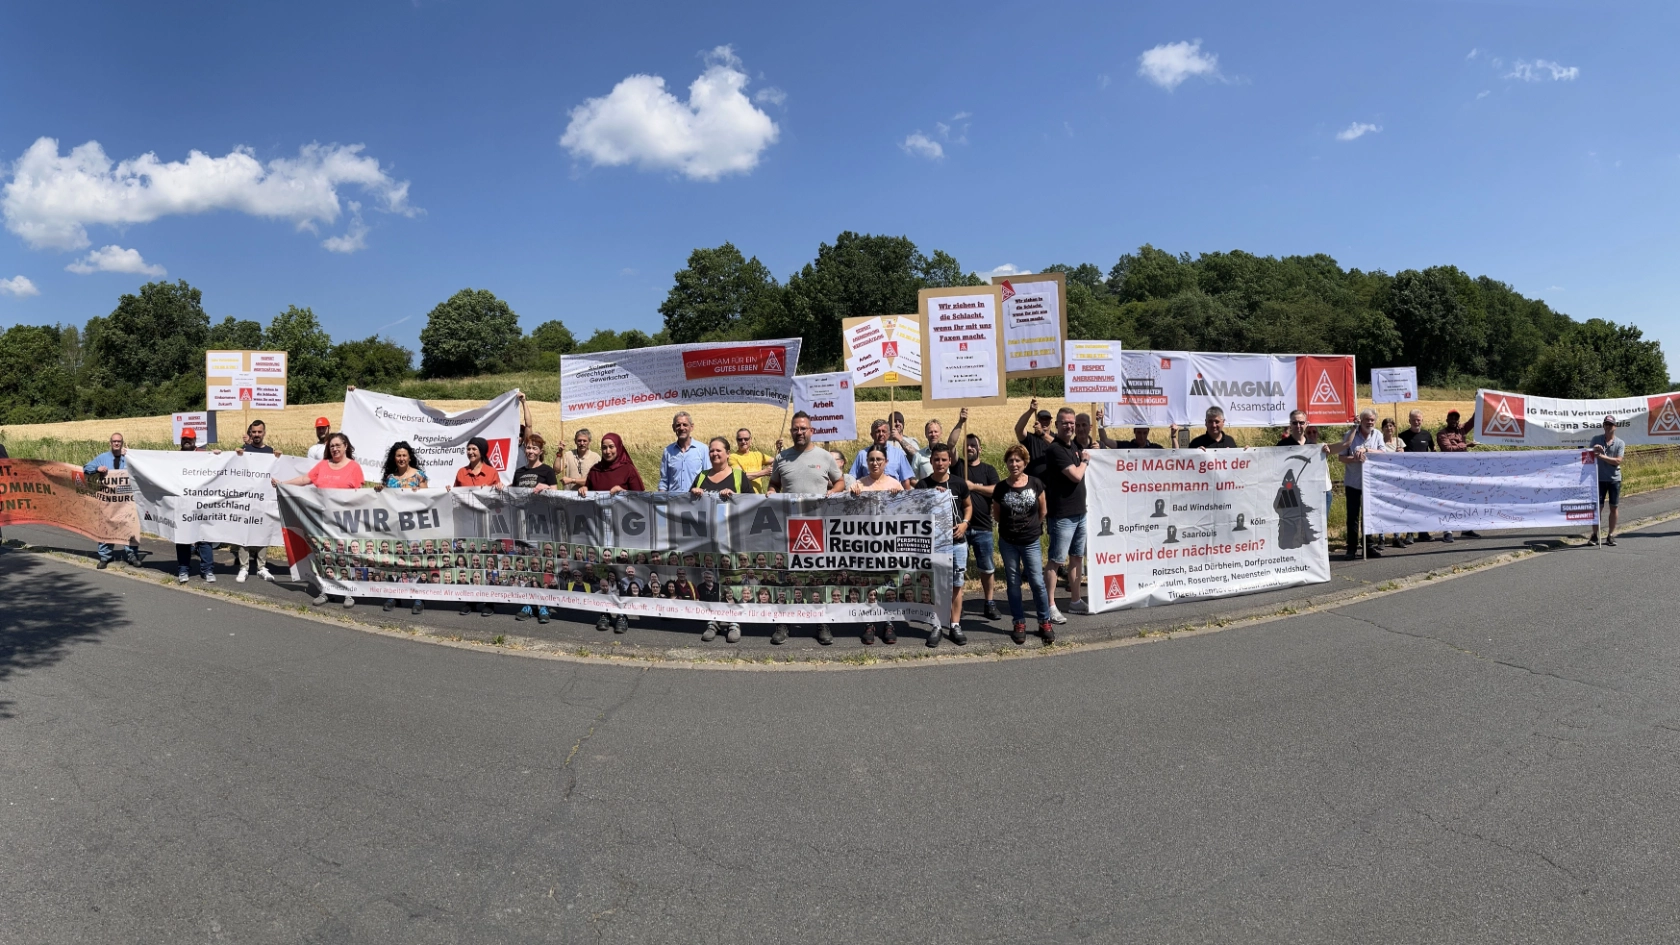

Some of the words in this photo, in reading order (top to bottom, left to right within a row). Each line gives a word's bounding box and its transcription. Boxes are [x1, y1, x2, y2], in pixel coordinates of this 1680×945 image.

[938, 302, 952, 310] Wir
[952, 312, 984, 320] Schlacht,
[939, 334, 961, 342] Faxen
[738, 364, 758, 372] LEBEN
[681, 386, 719, 398] MAGNA
[1069, 384, 1118, 393] WERTSCHÄTZUNG
[1212, 380, 1285, 397] MAGNA
[568, 390, 678, 412] www.gutes-leben.de
[812, 400, 834, 408] Arbeit
[1230, 401, 1286, 412] Assamstadt
[383, 410, 424, 422] Betriebsrat
[1526, 407, 1537, 415] IG
[1540, 408, 1569, 416] Metall
[1571, 406, 1647, 417] Vertrauensleute
[810, 414, 844, 422] nkommen
[1582, 420, 1631, 429] Saauis
[412, 446, 466, 455] ndortsicherung
[418, 458, 454, 466] utschland
[1116, 460, 1137, 471] Bei
[1141, 460, 1194, 471] MAGNA
[1198, 458, 1228, 474] geht
[1230, 459, 1251, 470] der
[182, 468, 227, 476] Betriebsrat
[230, 469, 270, 478] Heilbronn
[1121, 480, 1208, 493] Sensenmann
[1215, 480, 1244, 490] um...
[183, 488, 264, 500] Standortsicherung
[196, 501, 250, 511] Deutschland
[1172, 504, 1187, 512] Bad
[1189, 502, 1231, 512] Windsheim
[182, 513, 227, 522] Solidarität
[229, 514, 242, 522] für
[244, 516, 263, 525] alle!
[334, 508, 392, 533] WIR
[398, 508, 440, 532] BEI
[1250, 517, 1266, 526] Köln
[1438, 508, 1479, 525] MAGNA
[830, 518, 932, 536] ZUKUNFTS
[1118, 522, 1159, 534] Bopfingen
[1182, 530, 1217, 539] Saarlouis
[830, 537, 894, 554] REGION
[1095, 552, 1122, 566] Wer
[1124, 549, 1153, 563] wird
[1156, 546, 1177, 560] der
[1182, 543, 1231, 558] nächste
[1234, 538, 1265, 553] sein?
[790, 556, 932, 570] ASCHAFFENBURG
[1152, 566, 1186, 578] Roitzsch,
[1188, 564, 1203, 573] Bad
[1244, 556, 1296, 568] Dorfprozelten,
[1188, 575, 1230, 585] Rosenberg,
[1274, 565, 1310, 575] Waldshut-
[748, 608, 761, 617] für
[762, 608, 773, 618] die
[774, 611, 792, 620] ganze
[794, 608, 824, 618] Region!
